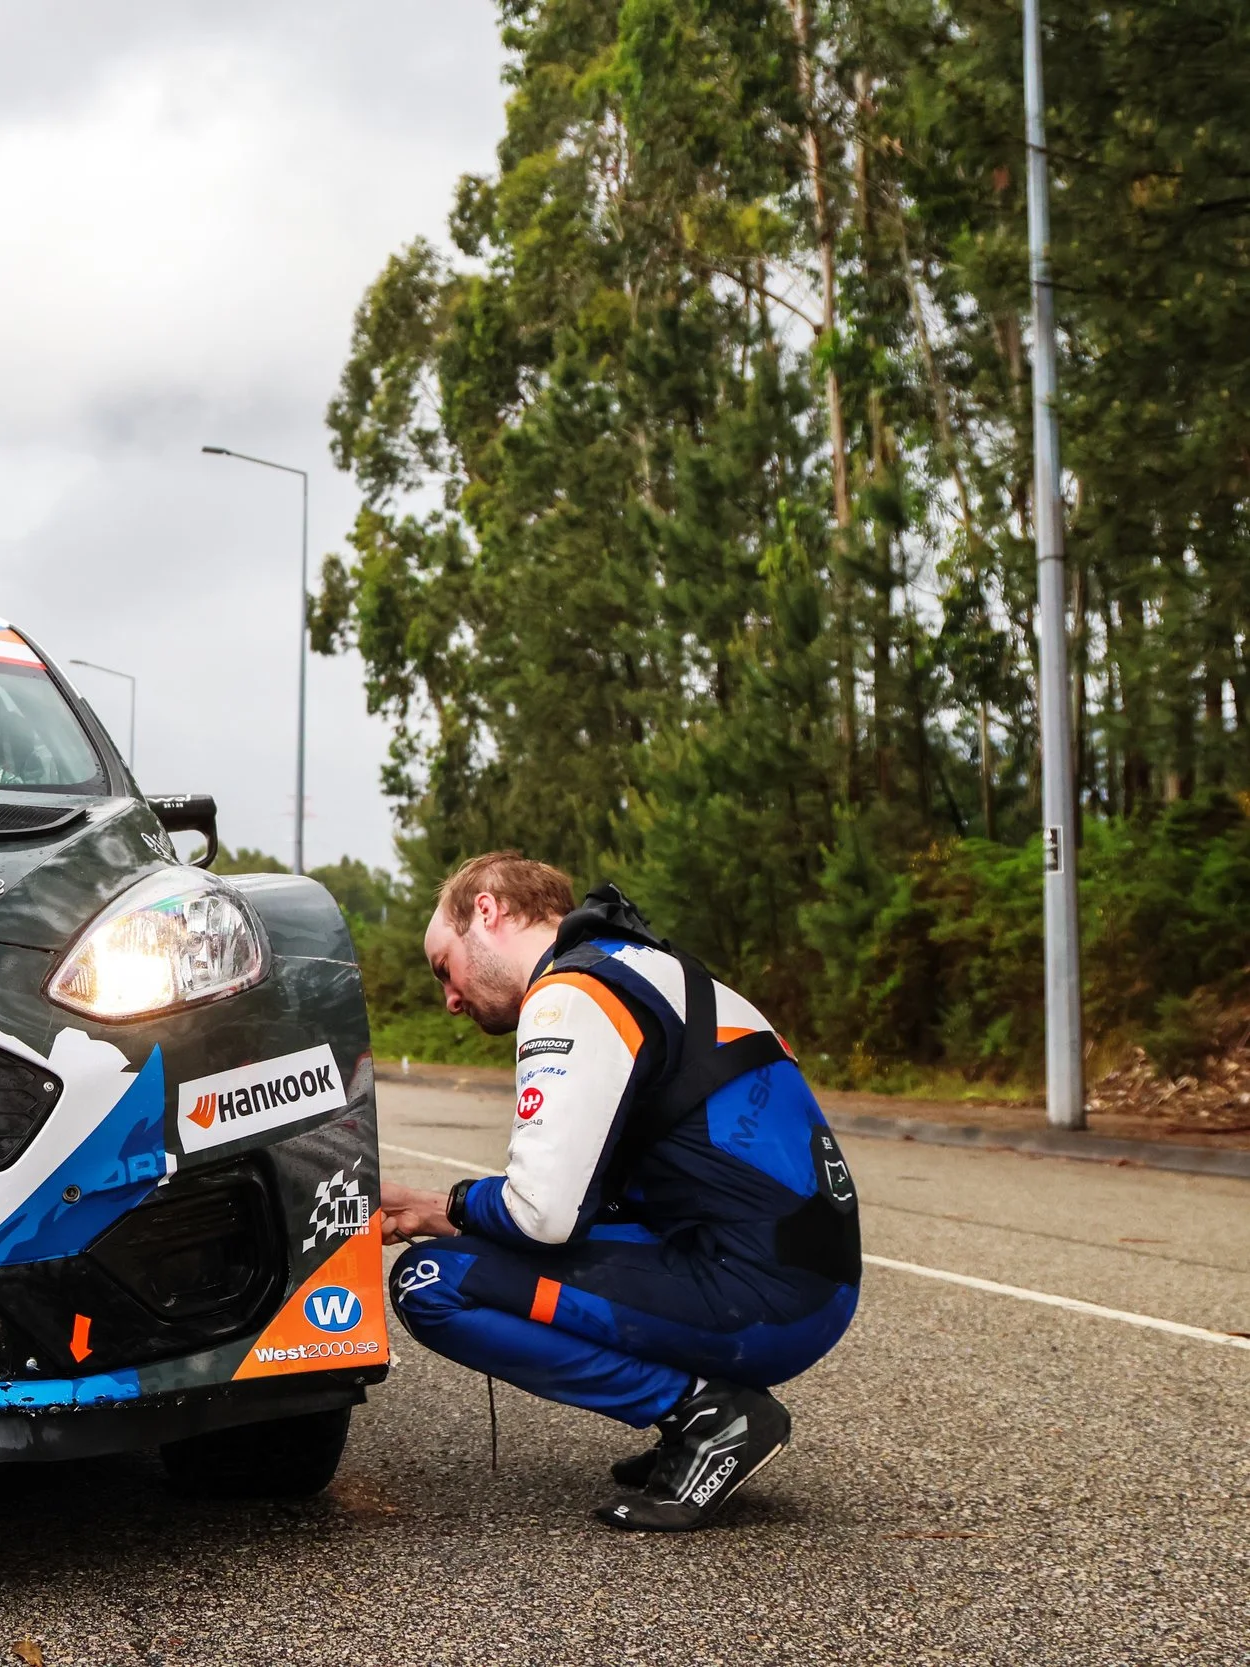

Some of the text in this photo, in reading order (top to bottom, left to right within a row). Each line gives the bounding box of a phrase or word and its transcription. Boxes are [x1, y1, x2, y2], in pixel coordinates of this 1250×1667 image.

[338, 1199, 358, 1225] M
[340, 1227, 370, 1236] POLAND
[254, 1340, 379, 1362] West2000.se
[692, 1456, 737, 1507] sparco
